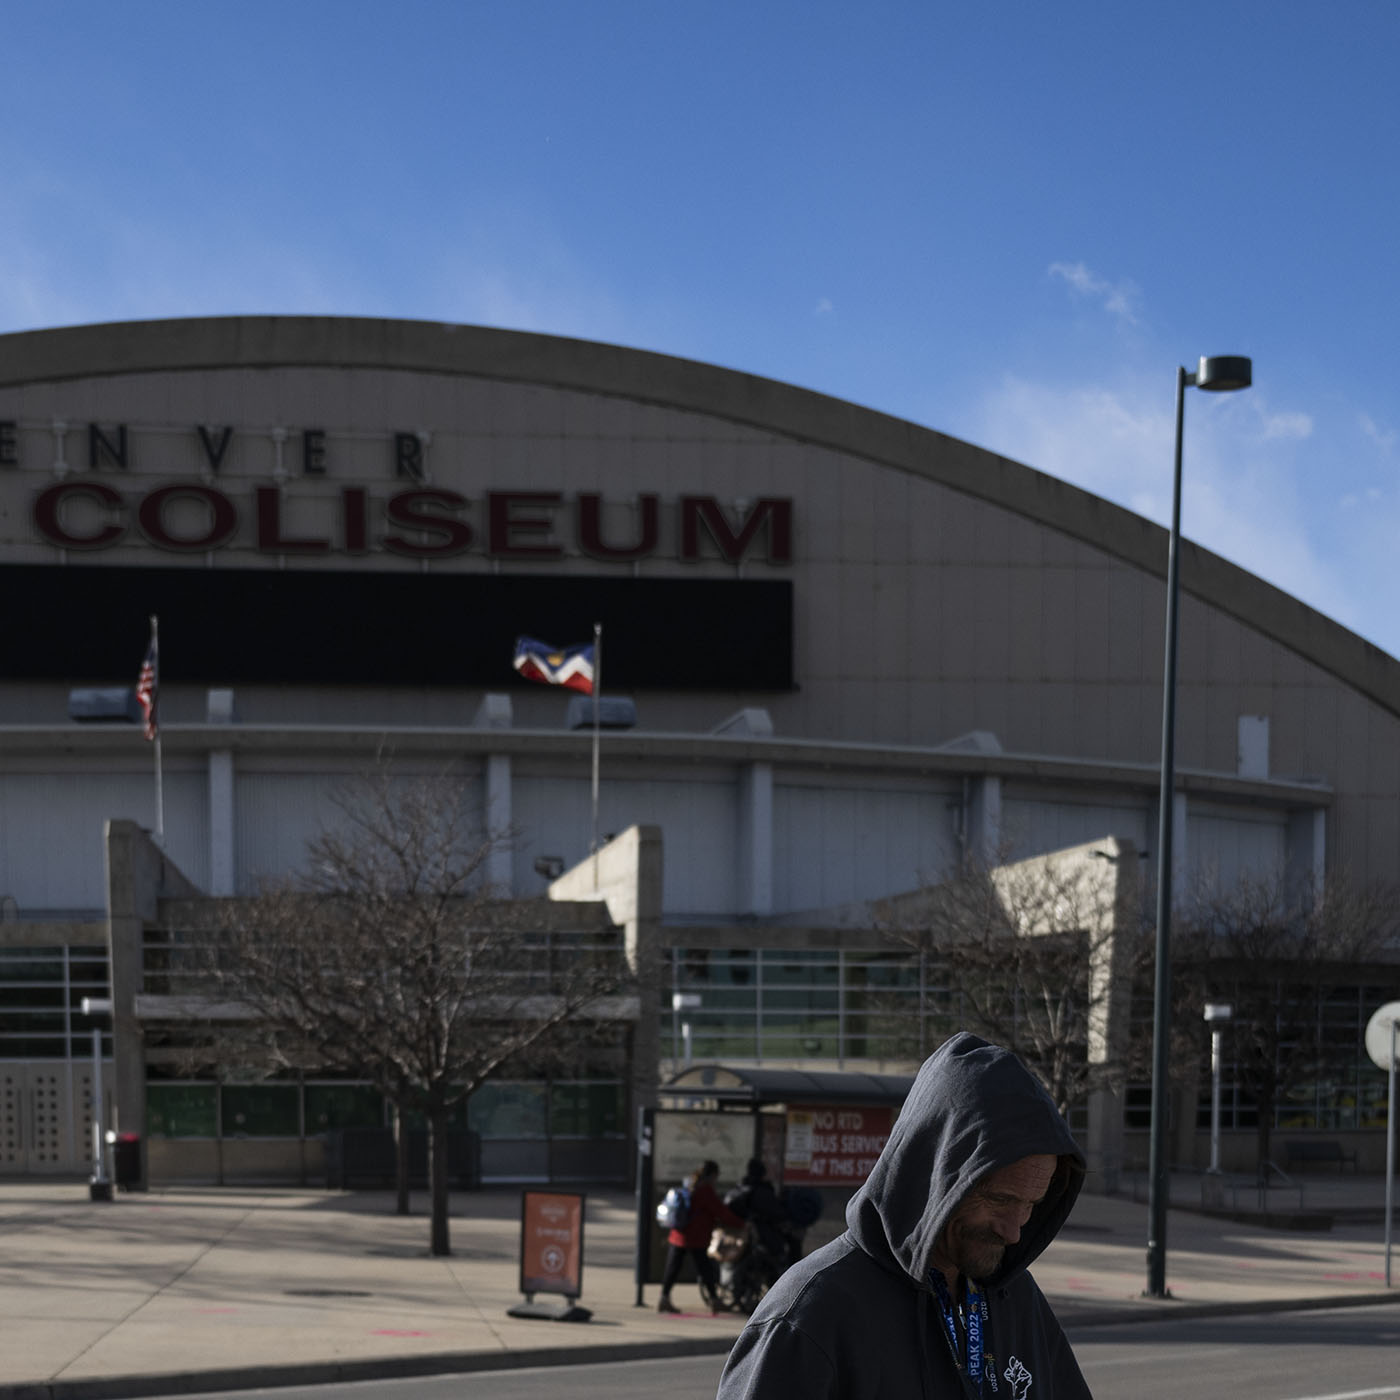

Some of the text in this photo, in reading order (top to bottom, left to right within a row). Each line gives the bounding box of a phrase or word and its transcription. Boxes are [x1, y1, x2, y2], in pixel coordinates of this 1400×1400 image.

[33, 481, 797, 564] COLISEUM
[813, 1112, 864, 1130] NO RTD
[812, 1134, 837, 1153] BUS
[809, 1157, 827, 1176] AT
[829, 1157, 854, 1176] THIS
[969, 1313, 980, 1376] PEAK 2022
